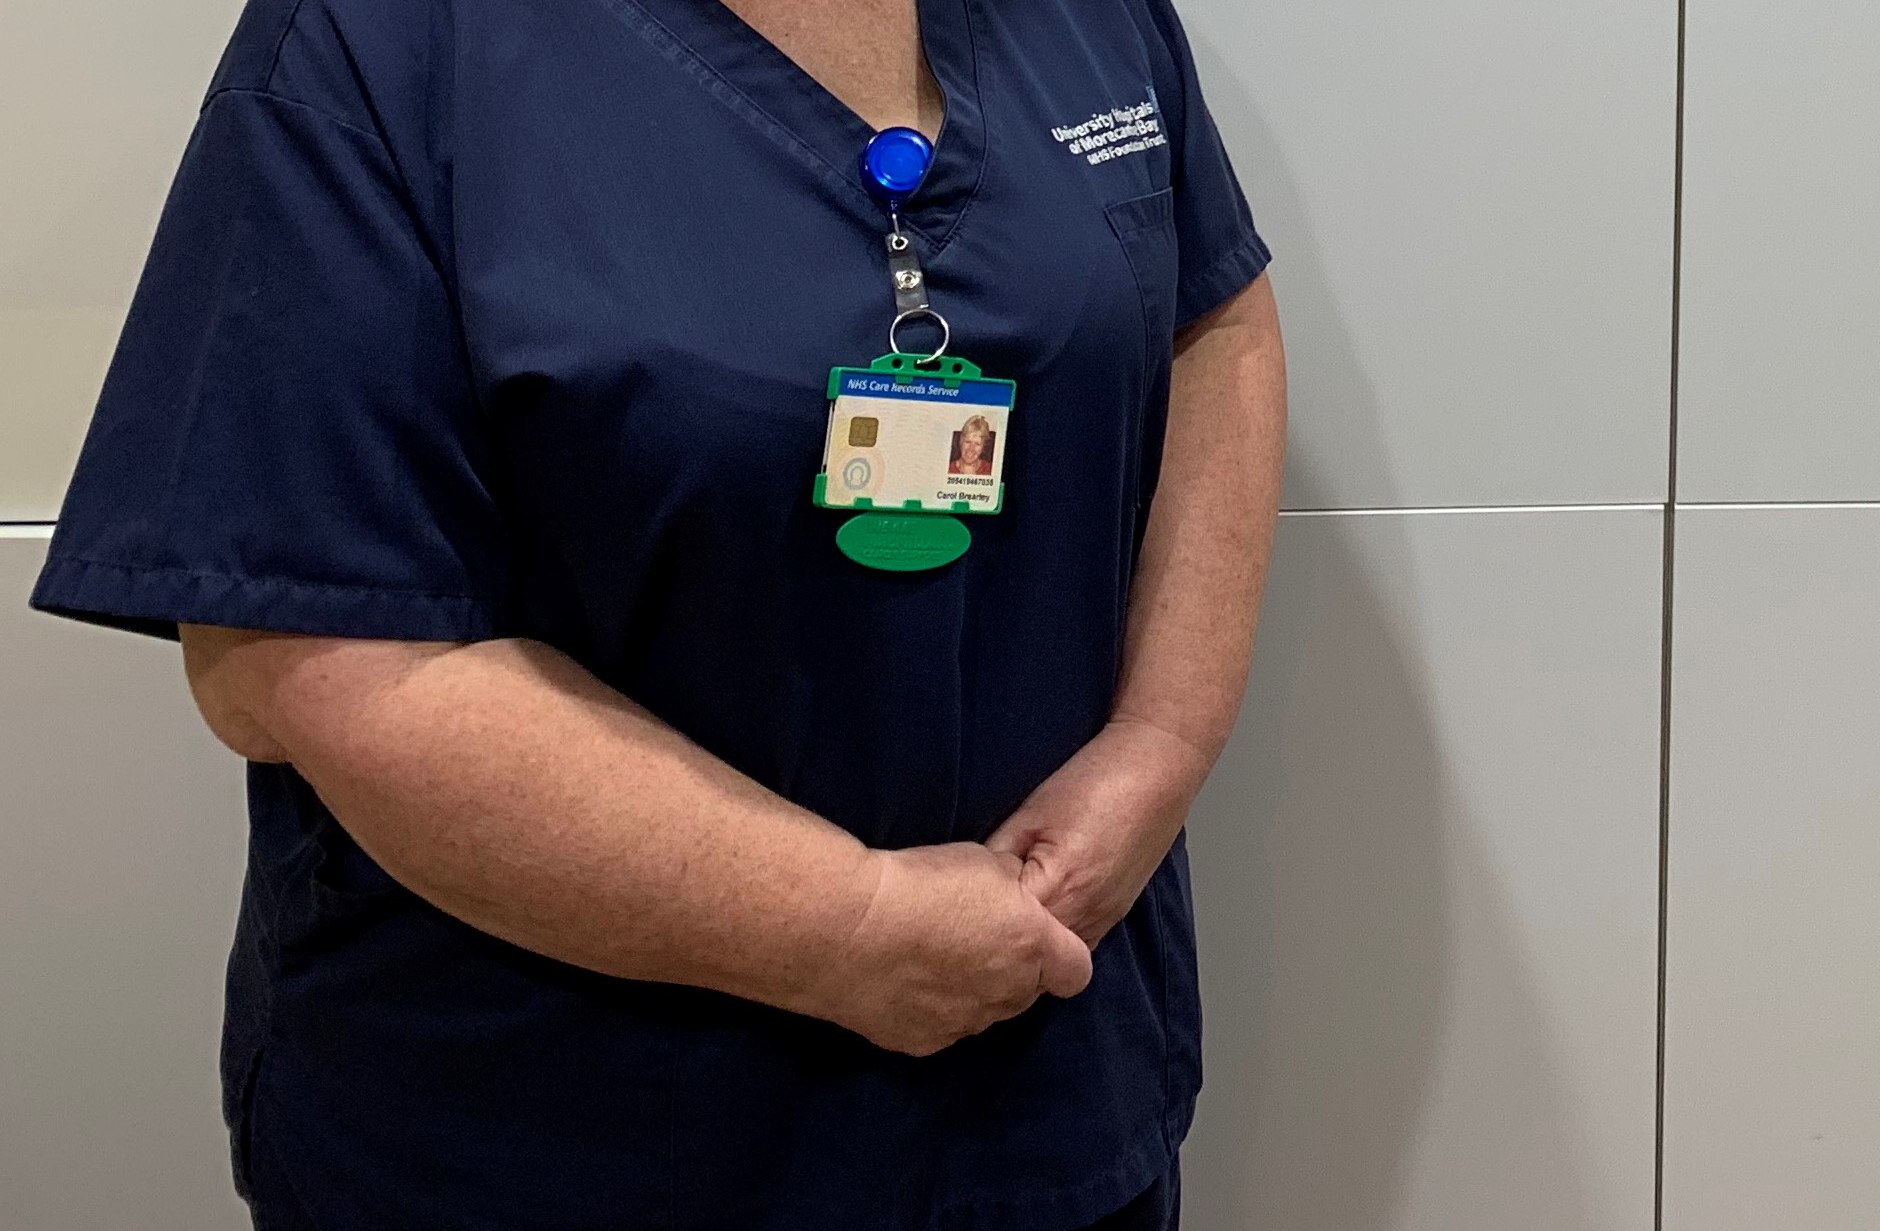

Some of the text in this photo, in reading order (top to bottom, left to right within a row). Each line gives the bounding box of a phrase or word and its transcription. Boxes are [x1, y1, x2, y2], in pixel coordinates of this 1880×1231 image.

[1069, 139, 1083, 155] of
[1135, 118, 1160, 136] Bay
[847, 378, 960, 397] NHS Care Records Service
[936, 490, 957, 500] Carol
